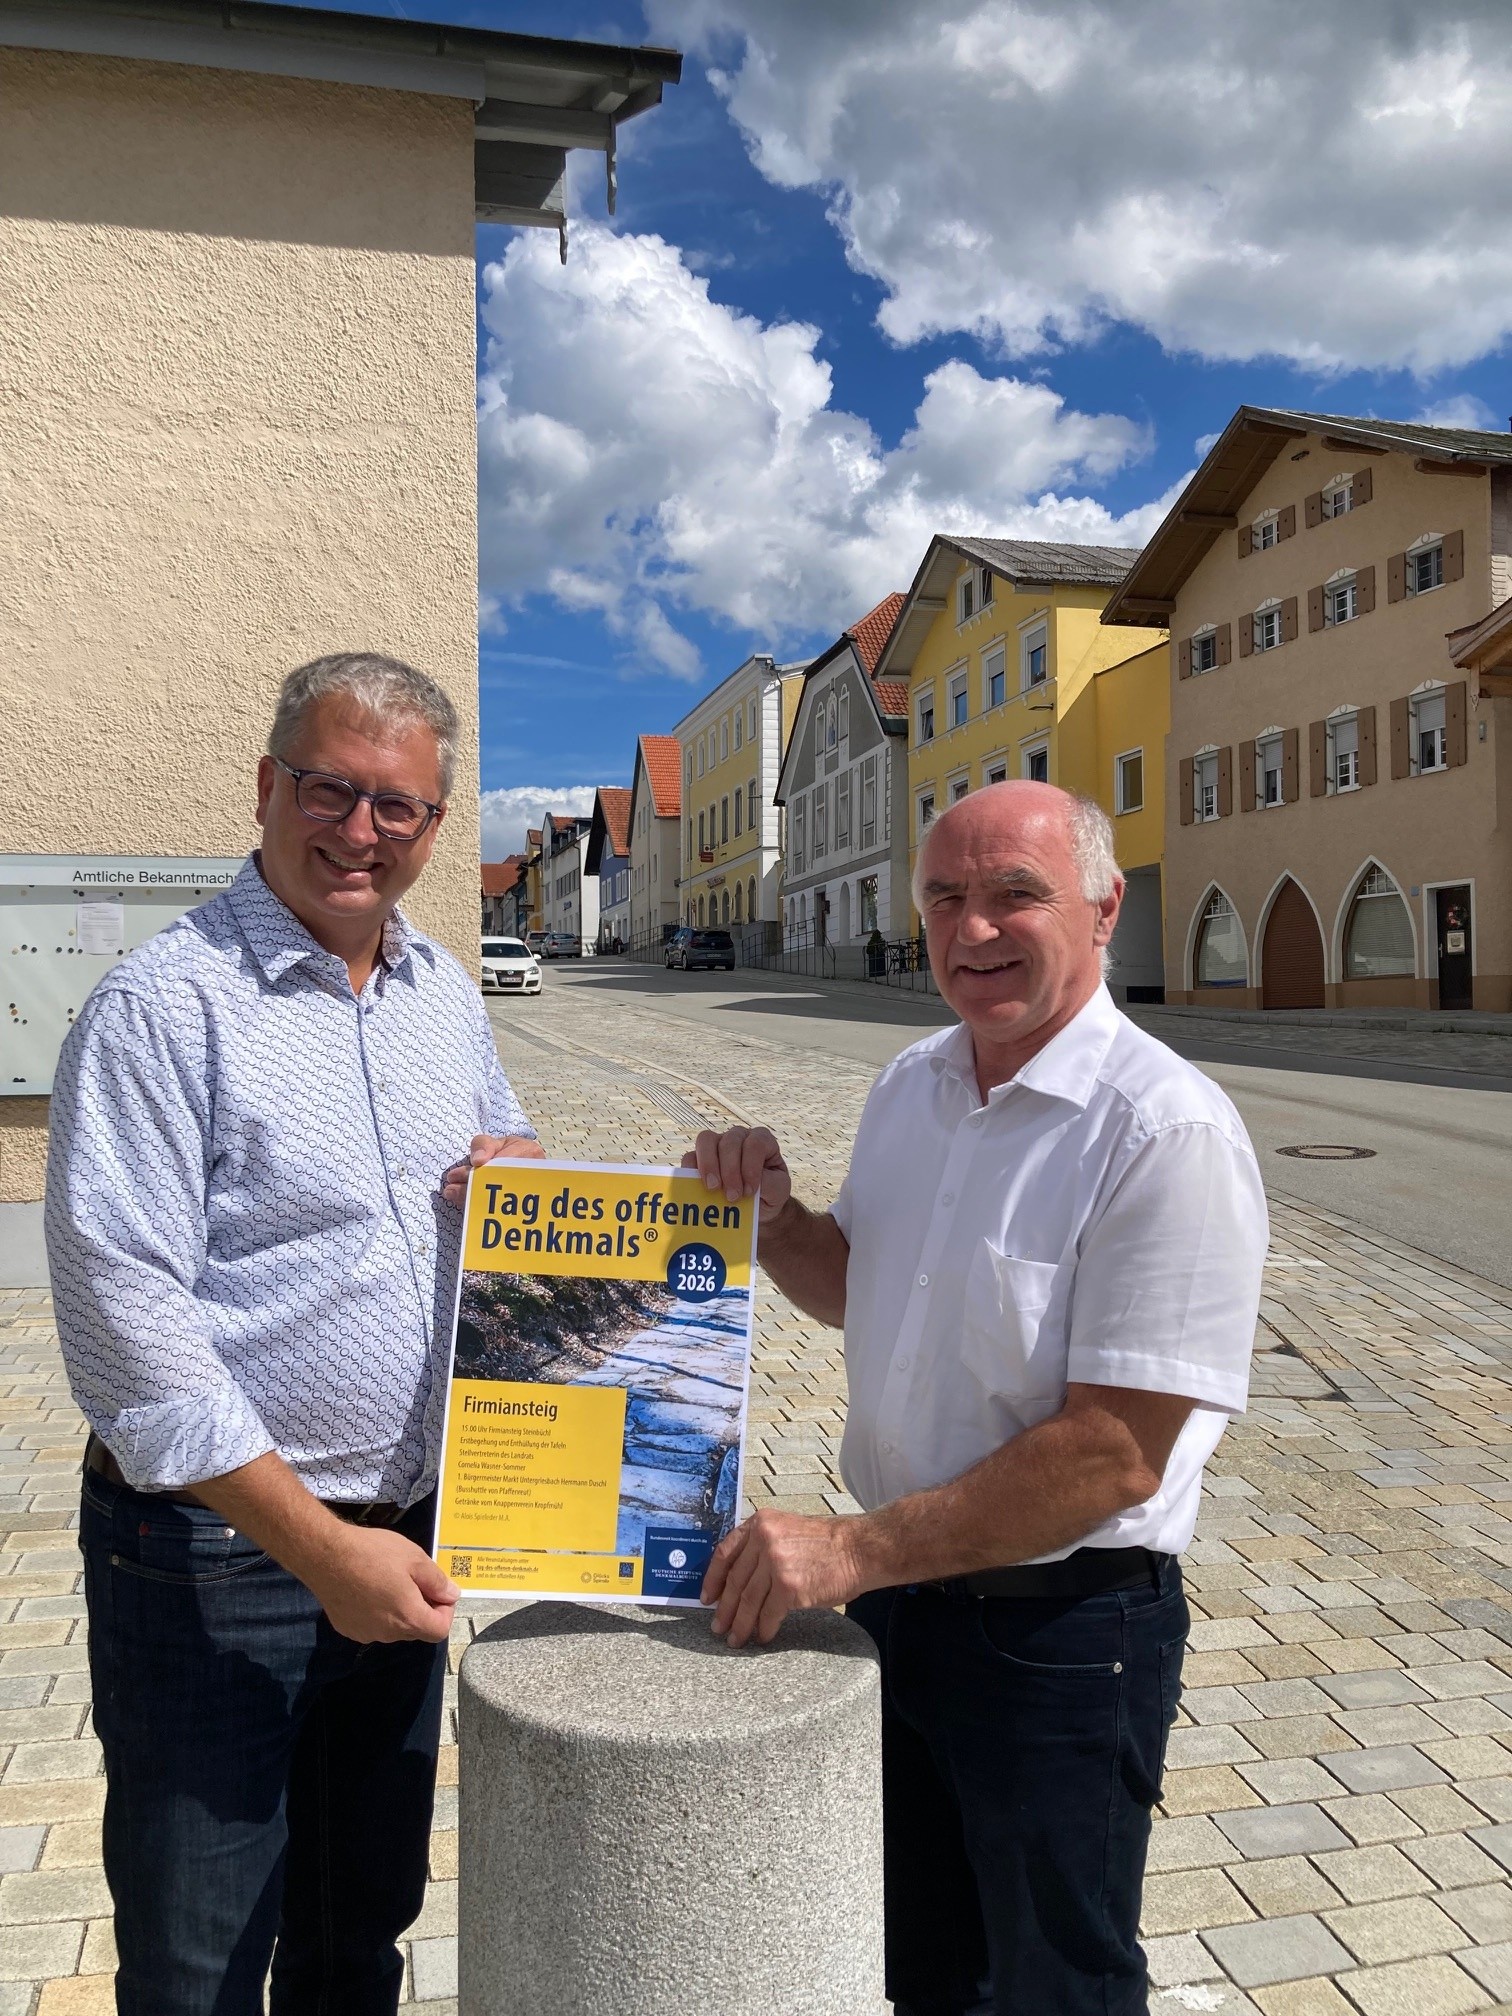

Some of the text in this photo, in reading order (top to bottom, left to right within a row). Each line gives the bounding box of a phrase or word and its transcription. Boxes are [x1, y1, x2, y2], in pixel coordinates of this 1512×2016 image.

[73, 870, 135, 883] Amtliche
[485, 1183, 741, 1229] Tag des offenen
[679, 1253, 717, 1272] 13.9.
[676, 1274, 716, 1292] 2026
[463, 1395, 558, 1421] Firmiansteig
[478, 1425, 488, 1433] Uhr
[488, 1426, 522, 1437] Firmiansteig
[460, 1437, 567, 1450] Erstbegehung und Enthüllung der Tafeln
[459, 1449, 534, 1460] Stellvertreterin des Landrats
[457, 1461, 526, 1471] Cornelia Wasner-Sommer
[463, 1473, 502, 1484] Bürgermeister
[502, 1475, 519, 1483] Markt
[519, 1476, 560, 1486] Untergriesbach
[456, 1485, 487, 1494] (Busshuttle
[499, 1487, 532, 1497] Pfaffenreut)
[455, 1497, 480, 1506] Getränke
[493, 1499, 534, 1509] Knappenverein
[534, 1501, 563, 1510] Kropfmühl
[460, 1512, 473, 1520] Alois
